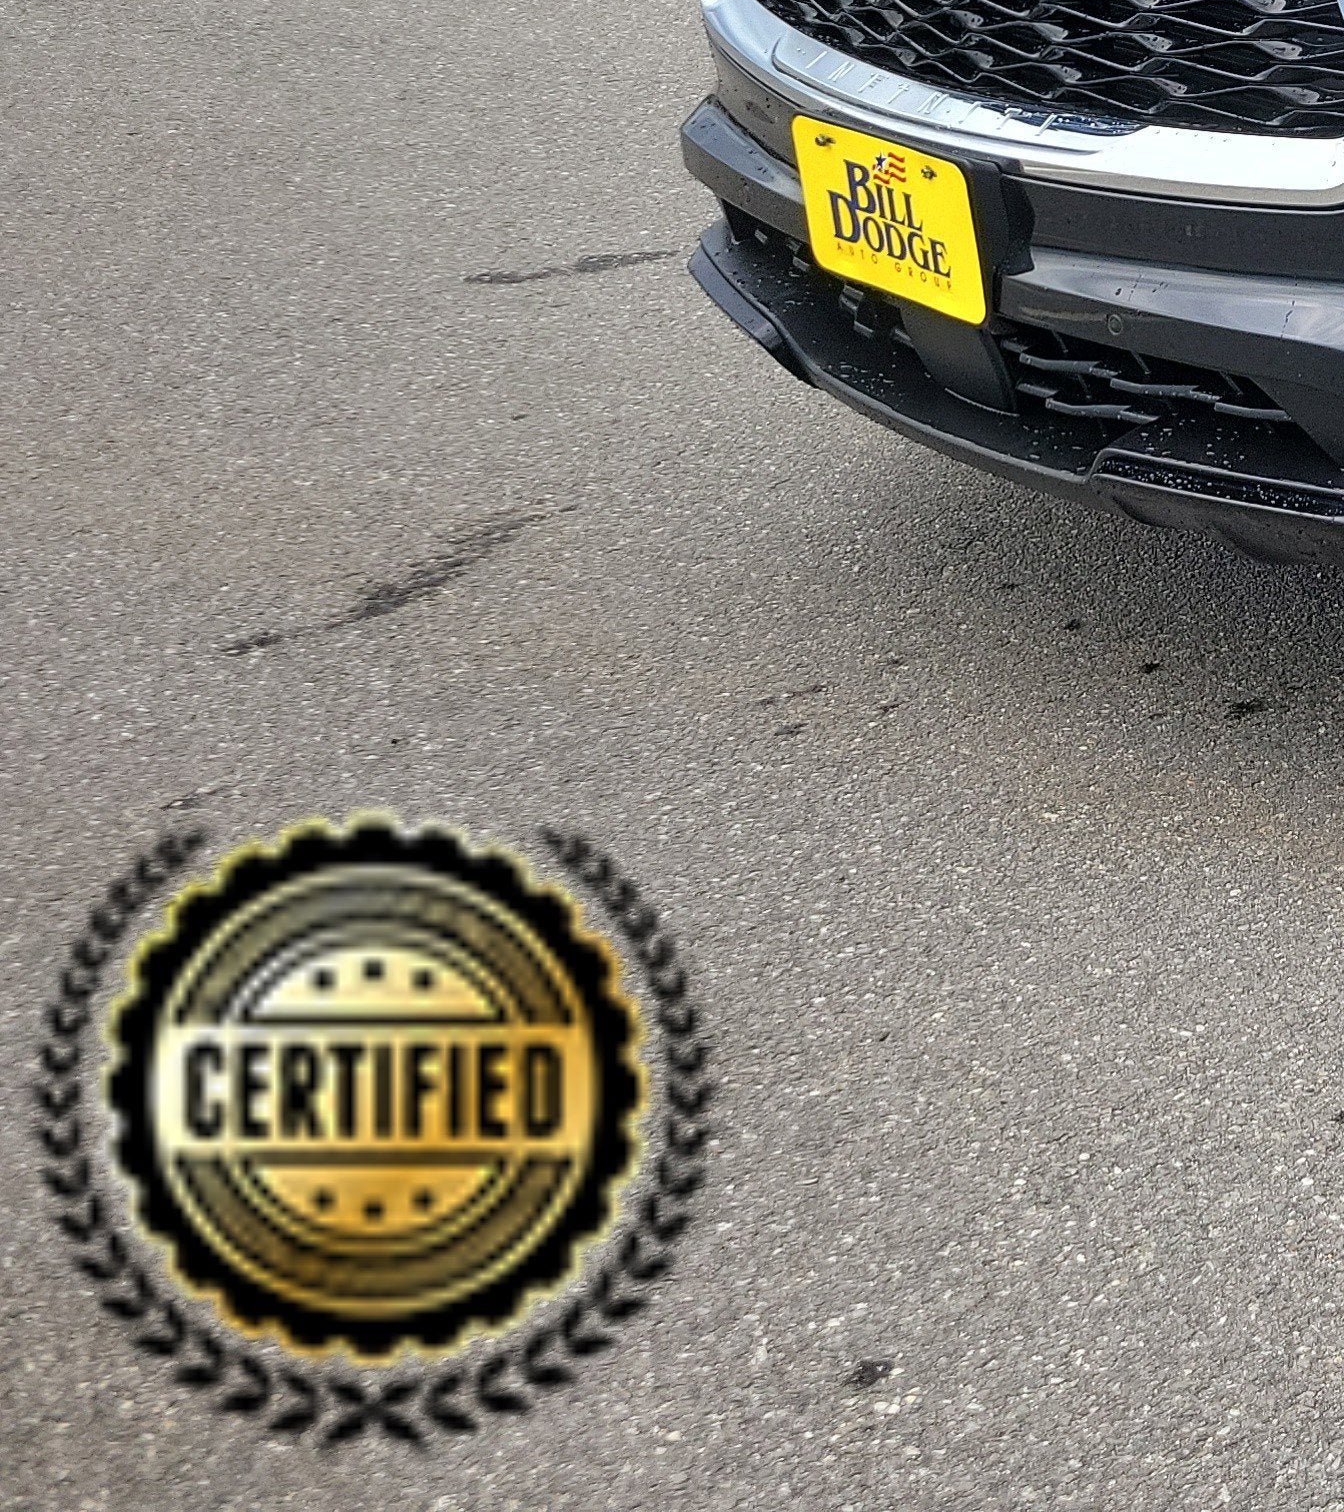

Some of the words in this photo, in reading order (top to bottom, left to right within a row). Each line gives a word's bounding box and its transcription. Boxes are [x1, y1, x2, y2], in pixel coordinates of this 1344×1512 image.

[843, 158, 923, 232] BILL
[826, 189, 952, 279] DODGE
[837, 242, 878, 264] AUTO
[895, 262, 952, 291] GROUP
